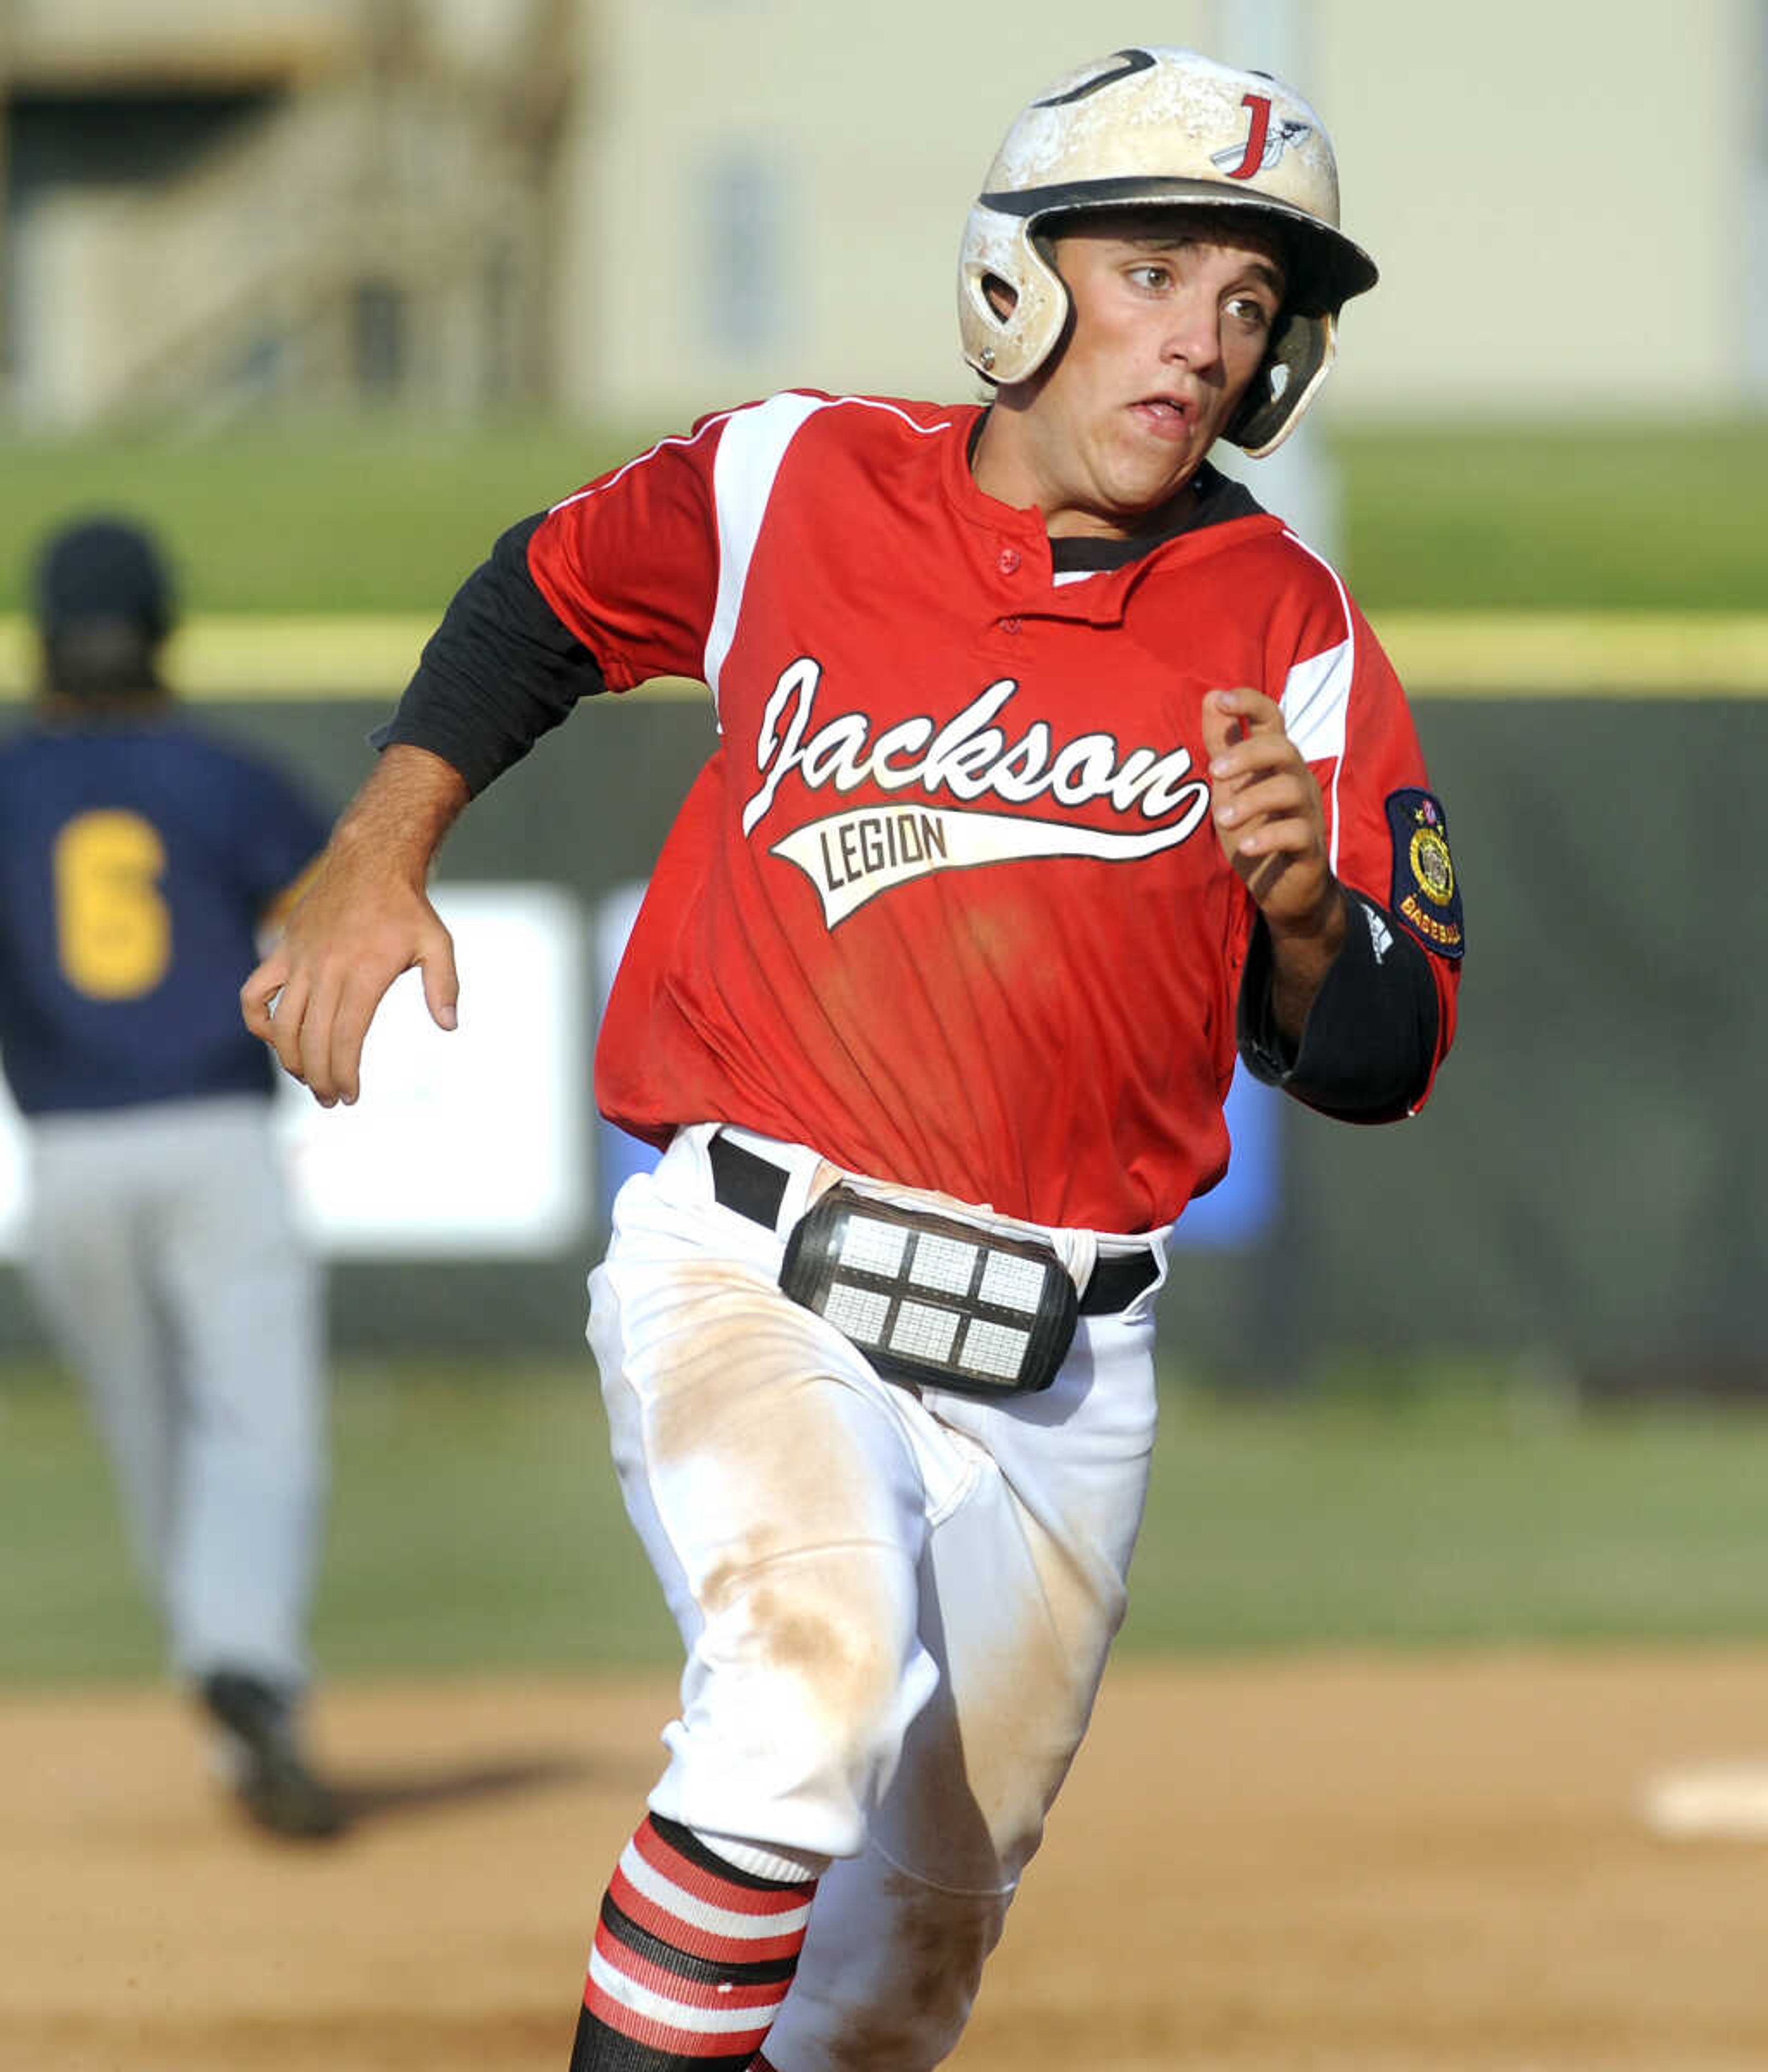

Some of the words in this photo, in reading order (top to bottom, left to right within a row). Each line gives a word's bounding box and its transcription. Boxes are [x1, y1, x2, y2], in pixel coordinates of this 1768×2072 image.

[1224, 93, 1272, 180] J
[742, 656, 1199, 839] Jackson
[54, 809, 172, 1001] 6
[820, 813, 948, 891] LEGION
